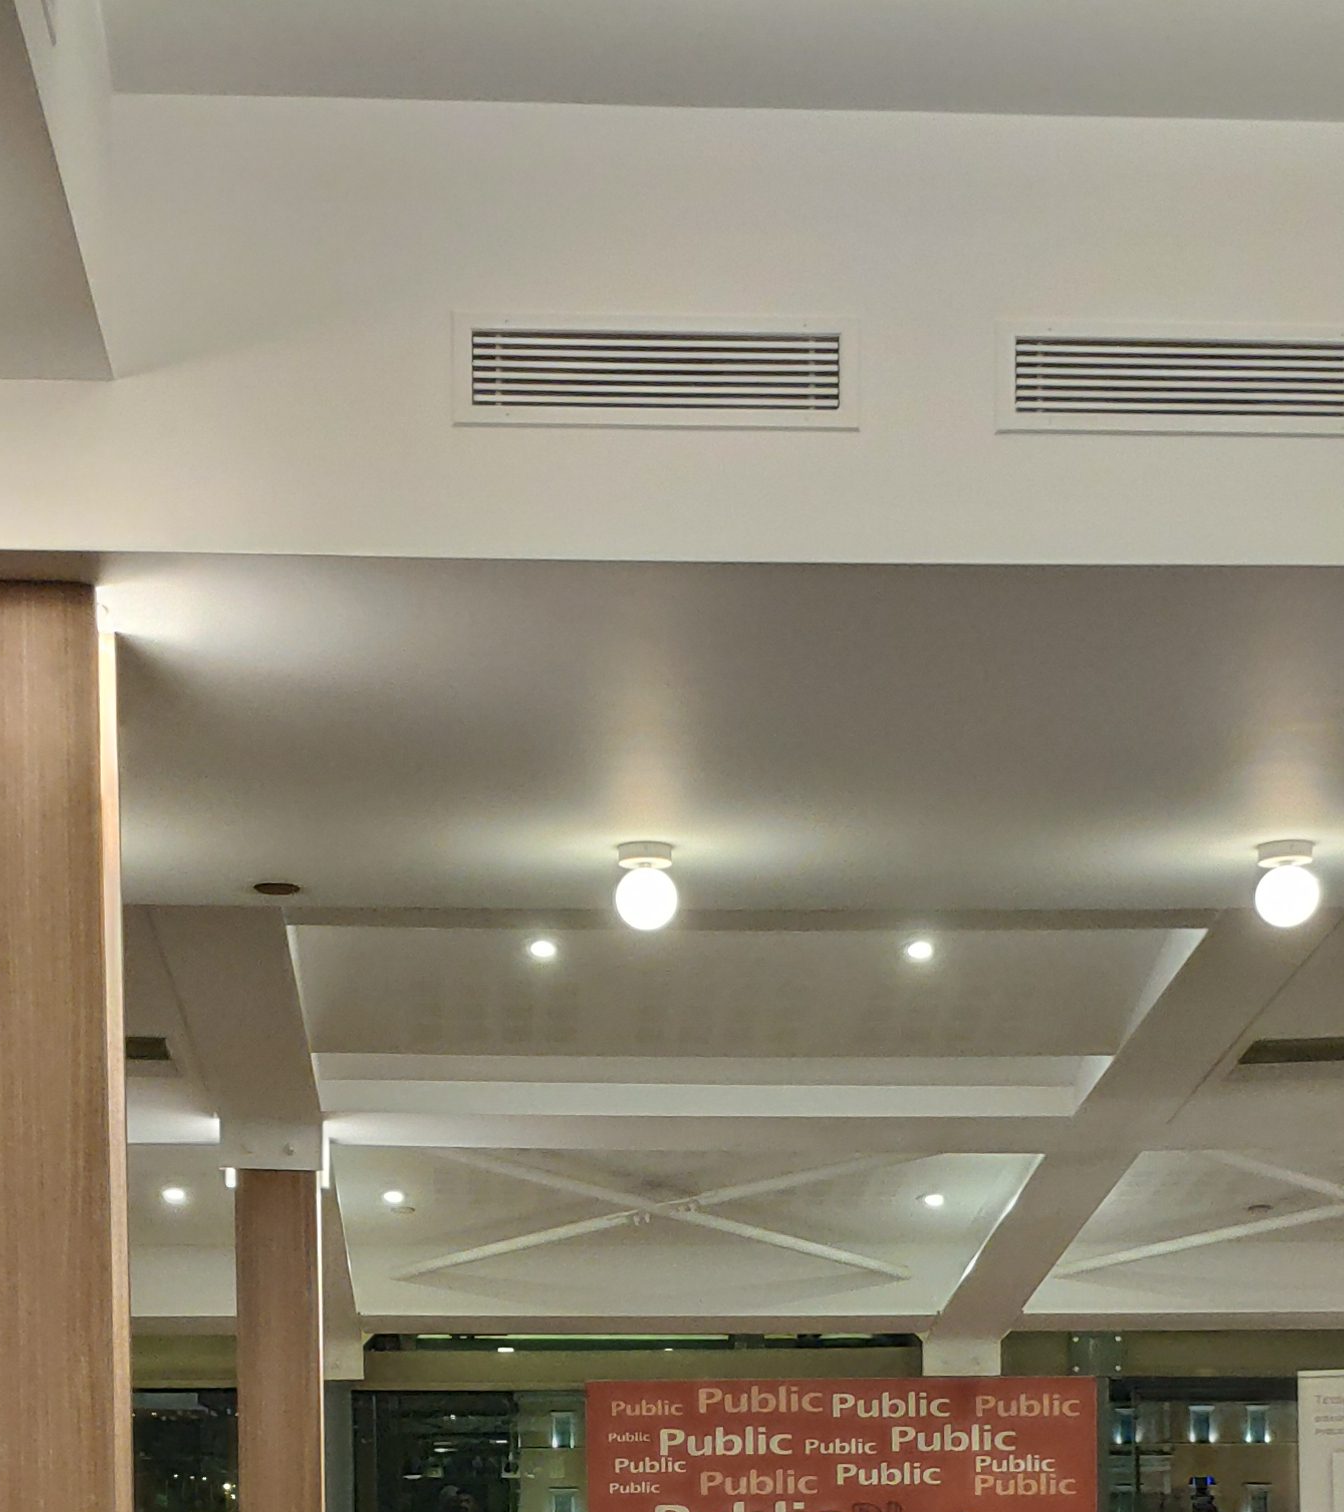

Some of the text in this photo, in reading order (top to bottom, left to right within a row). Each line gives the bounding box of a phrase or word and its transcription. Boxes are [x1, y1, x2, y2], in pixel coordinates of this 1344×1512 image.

[611, 1385, 1081, 1419] Public Public Public Public
[608, 1426, 878, 1457] Public Public Public
[891, 1424, 1018, 1452] Public
[614, 1457, 687, 1474] Public
[836, 1462, 942, 1486] Public
[975, 1454, 1056, 1473] Public
[609, 1482, 661, 1495] Public
[700, 1469, 819, 1496] Public
[974, 1473, 1078, 1496] Public
